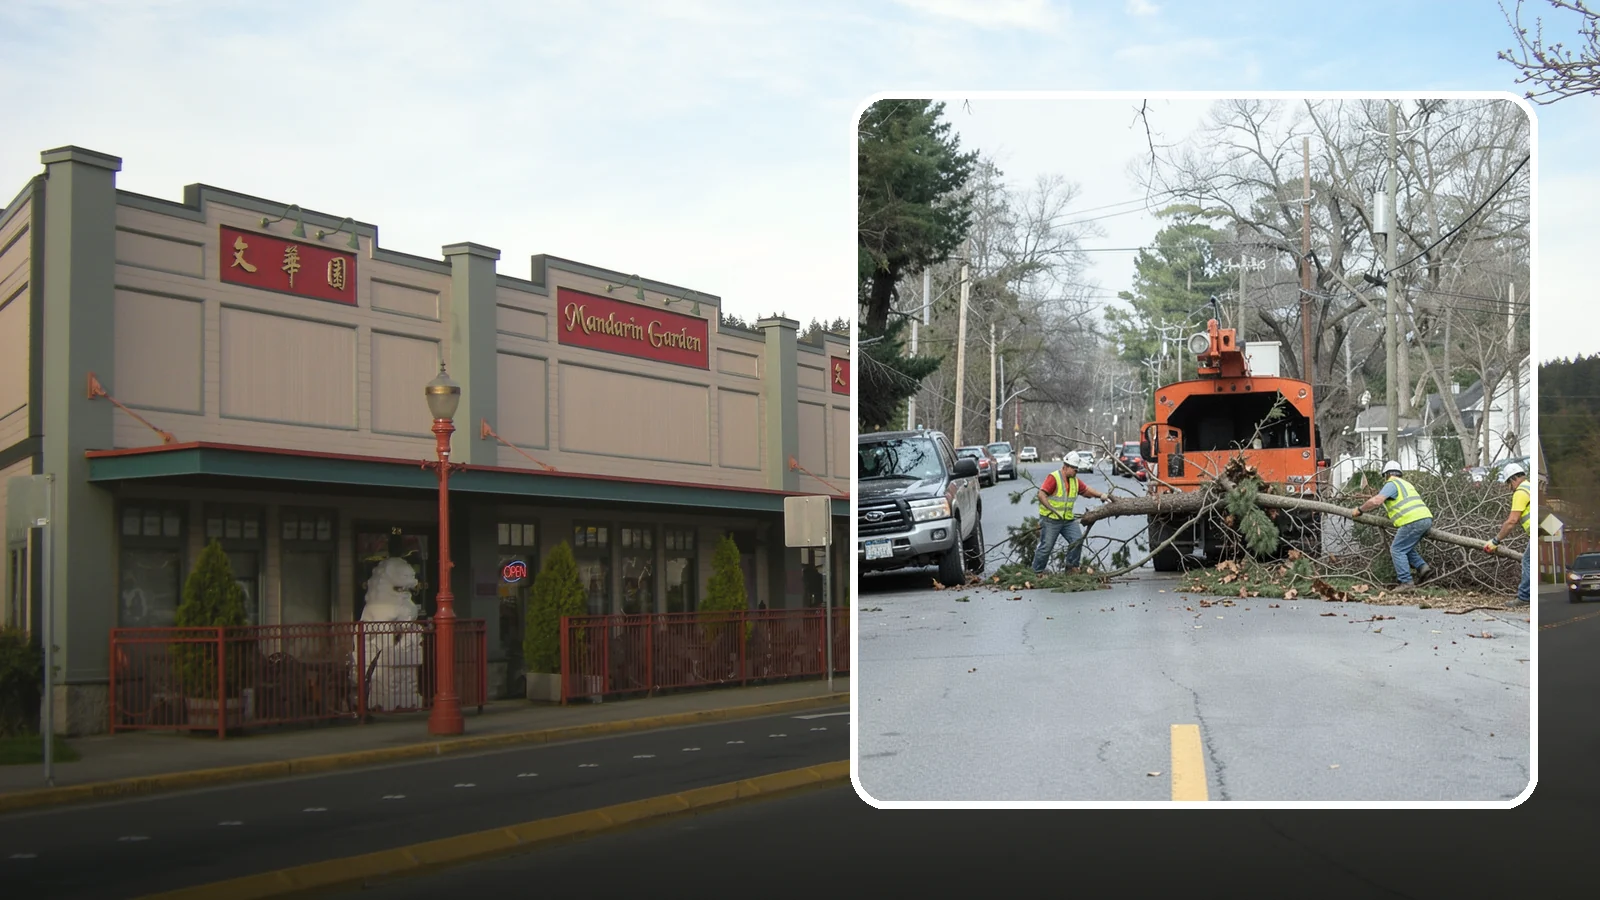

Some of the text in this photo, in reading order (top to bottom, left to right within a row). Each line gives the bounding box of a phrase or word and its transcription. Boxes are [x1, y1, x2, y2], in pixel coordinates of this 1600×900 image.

[564, 302, 701, 352] Mandarin Garden
[503, 565, 527, 578] OPEN
